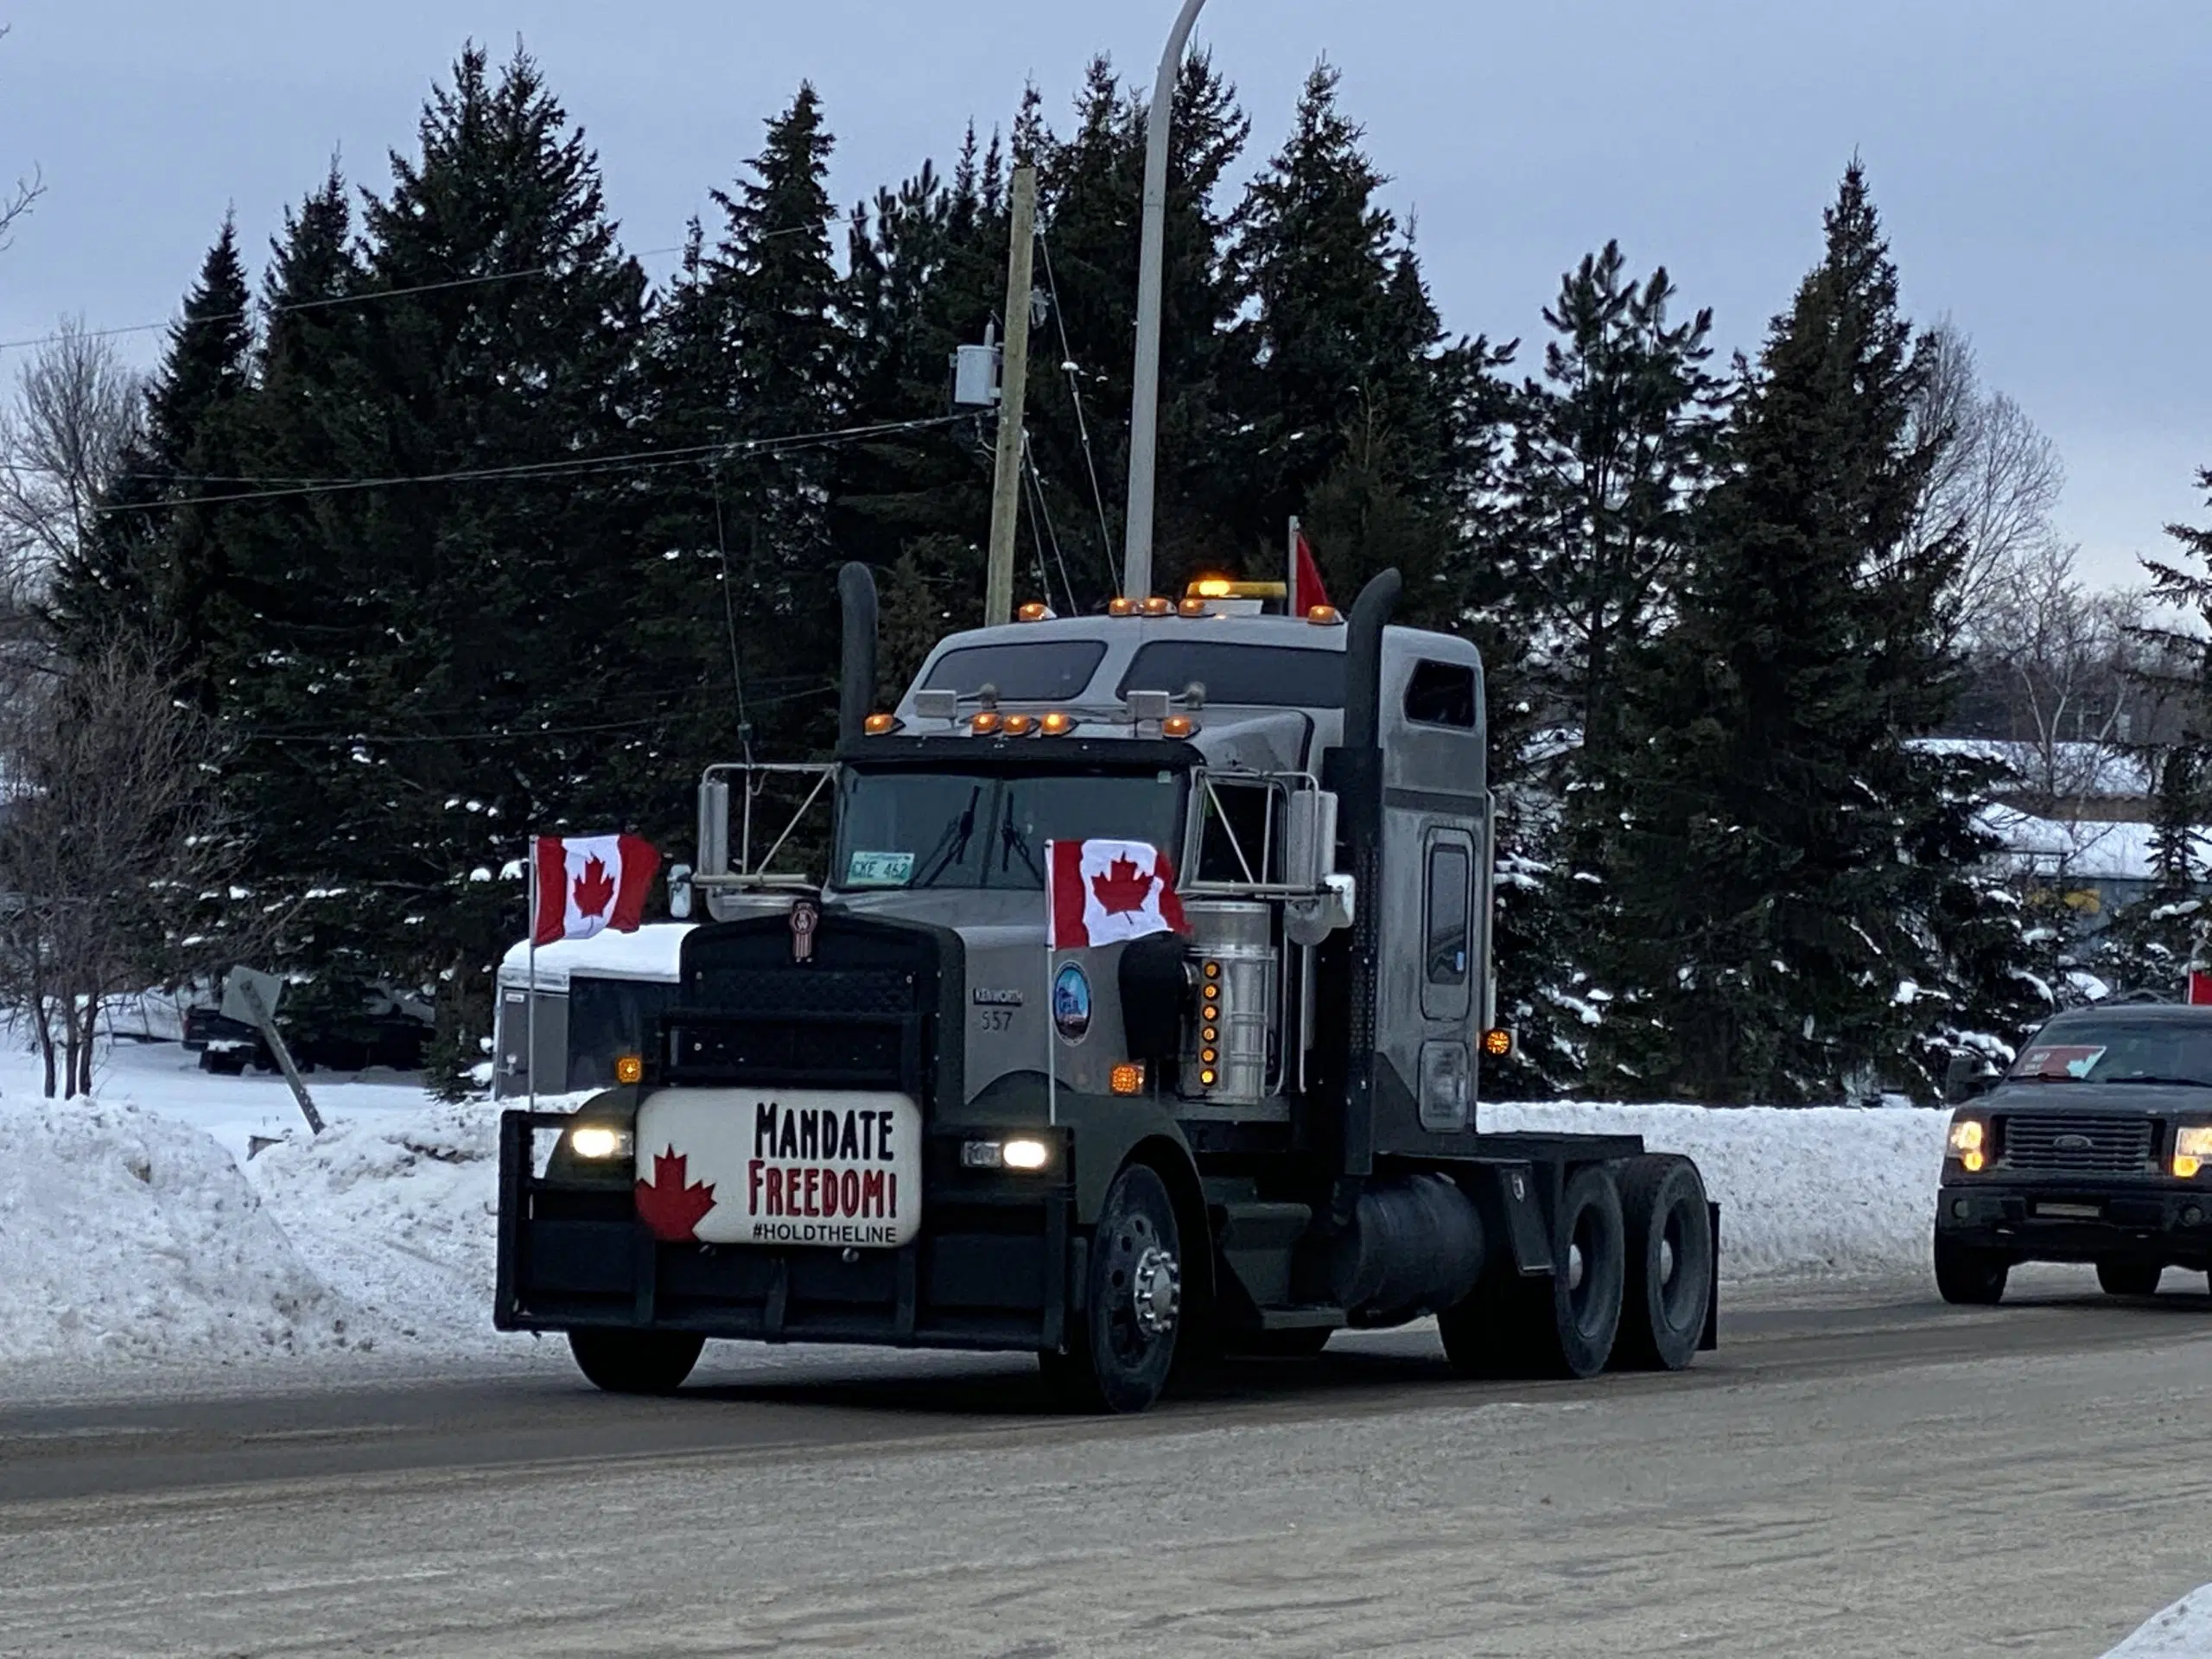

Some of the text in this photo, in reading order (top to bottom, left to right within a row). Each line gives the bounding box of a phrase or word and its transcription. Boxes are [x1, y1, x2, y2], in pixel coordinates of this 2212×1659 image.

[982, 1010, 1014, 1031] 557
[754, 1102, 894, 1160] MANDATE
[748, 1159, 897, 1218] FREEDOM!
[753, 1224, 897, 1243] #HOLDTHELINE
